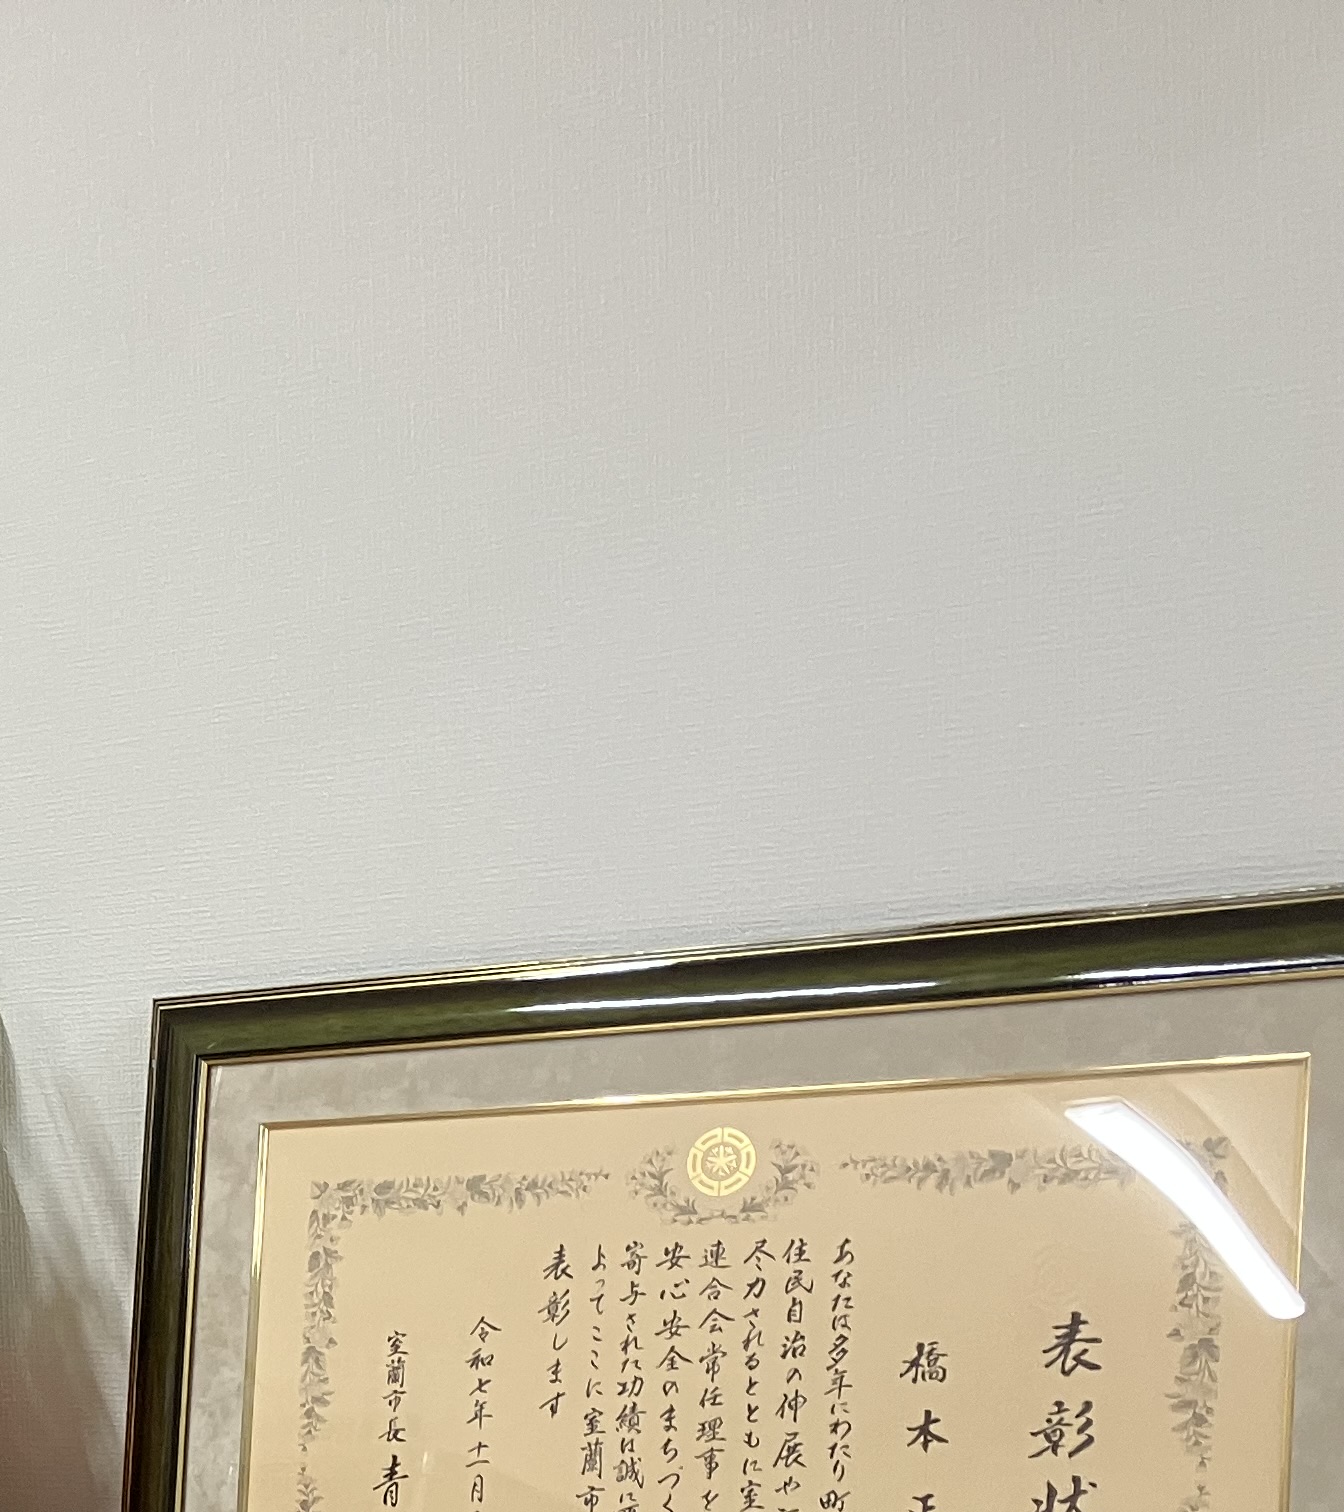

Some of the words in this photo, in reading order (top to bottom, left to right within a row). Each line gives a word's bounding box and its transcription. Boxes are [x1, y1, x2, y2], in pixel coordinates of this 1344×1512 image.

[538, 1243, 574, 1419] 表彰します
